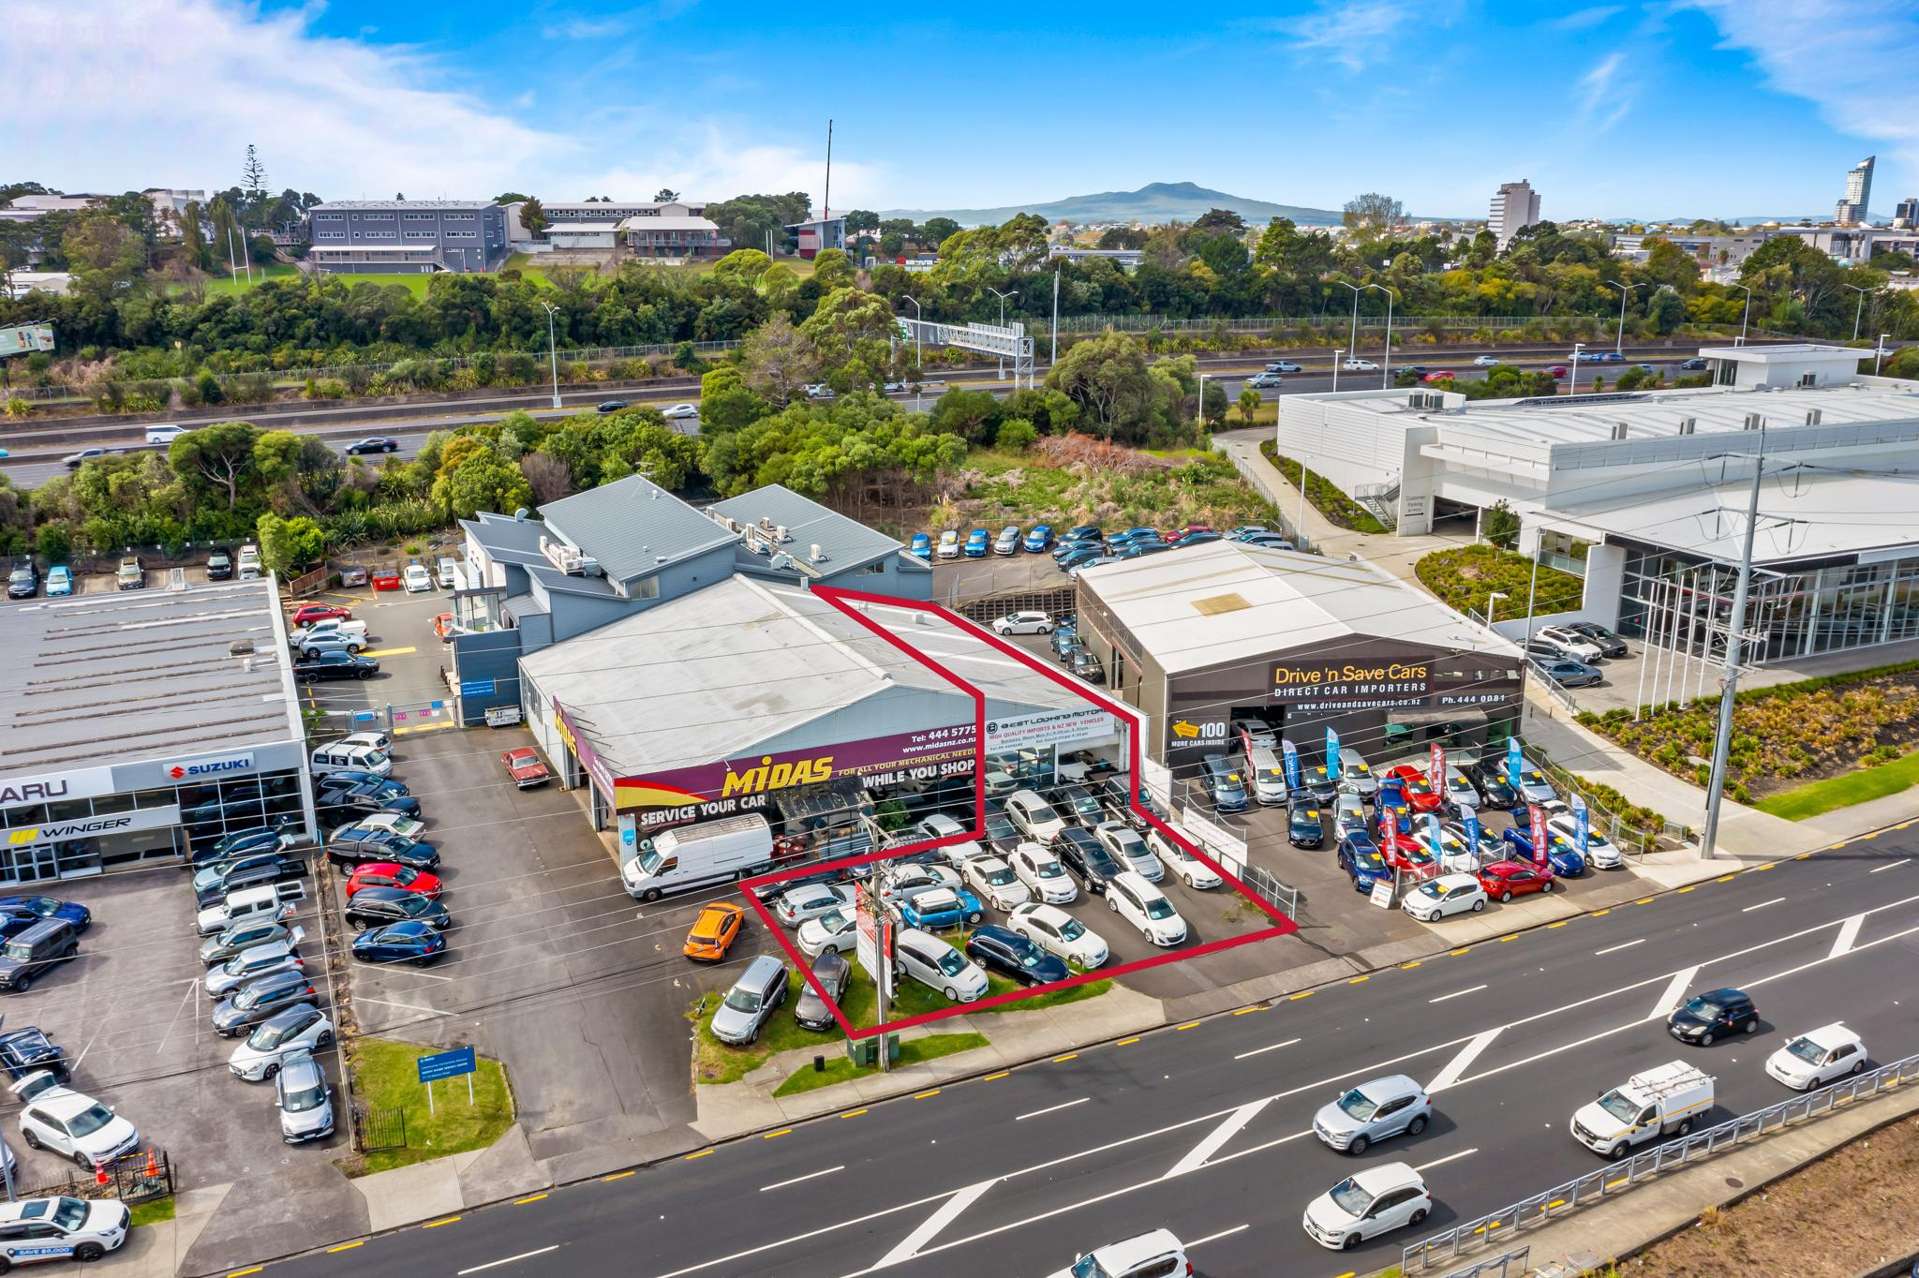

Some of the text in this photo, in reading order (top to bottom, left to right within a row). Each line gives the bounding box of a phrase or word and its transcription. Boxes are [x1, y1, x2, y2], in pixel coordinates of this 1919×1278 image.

[1275, 663, 1427, 684] Drive 'n Save Cars
[1274, 682, 1426, 697] DIRECT CAR IMPORTERS
[1480, 694, 1505, 702] 0081
[911, 725, 977, 743] Tel: 444 5775
[1200, 722, 1226, 738] 100
[188, 758, 249, 775] SUZUKI
[857, 764, 873, 774] ALL
[896, 752, 951, 767] MECHANICAL
[862, 759, 975, 788] WHILE YOU SHOP
[641, 795, 766, 826] SERVICE YOUR CAR
[42, 817, 131, 838] WINGER
